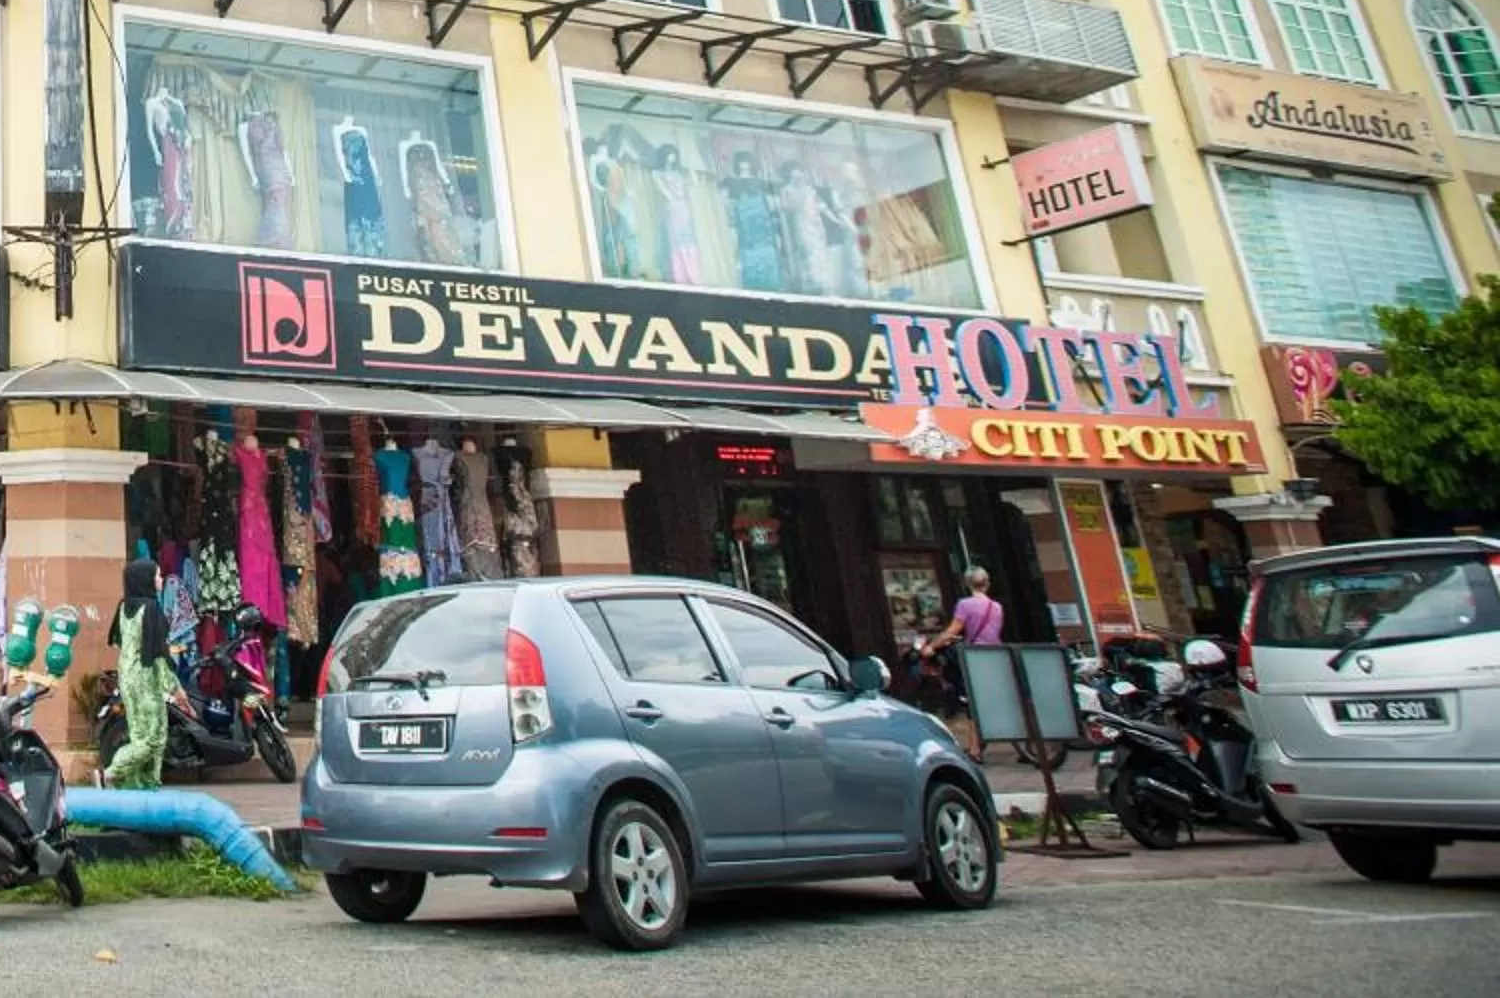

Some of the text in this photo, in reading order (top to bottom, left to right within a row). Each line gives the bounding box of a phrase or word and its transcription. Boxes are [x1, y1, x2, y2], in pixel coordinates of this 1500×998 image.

[1247, 91, 1417, 146] Andalusia
[1027, 168, 1125, 219] HOTEL
[358, 274, 535, 304] PUSAT TEKSTIL
[358, 294, 967, 388] DEWANDA
[871, 313, 1220, 419] HOTEL
[971, 418, 1250, 466] CITI POINT
